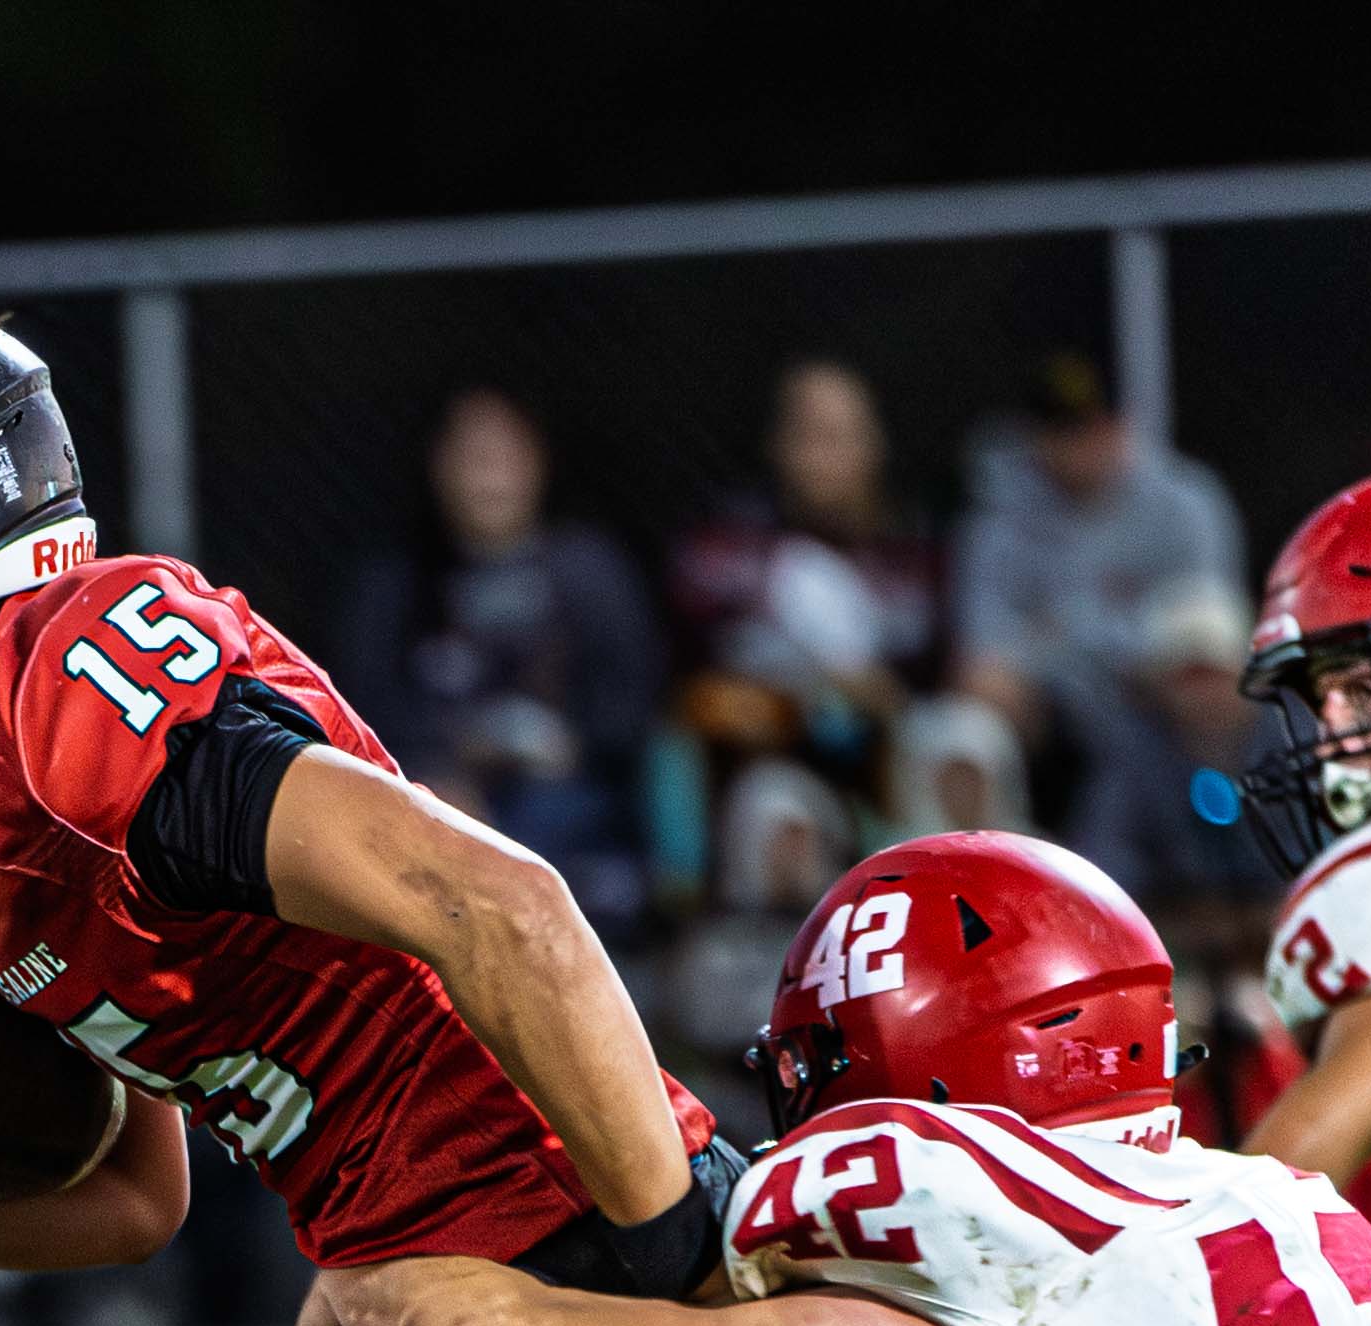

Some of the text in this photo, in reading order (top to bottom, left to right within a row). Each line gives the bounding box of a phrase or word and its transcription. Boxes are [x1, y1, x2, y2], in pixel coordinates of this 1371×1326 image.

[63, 580, 221, 740] 15
[800, 892, 913, 1009] 42
[732, 1134, 922, 1263] 42
